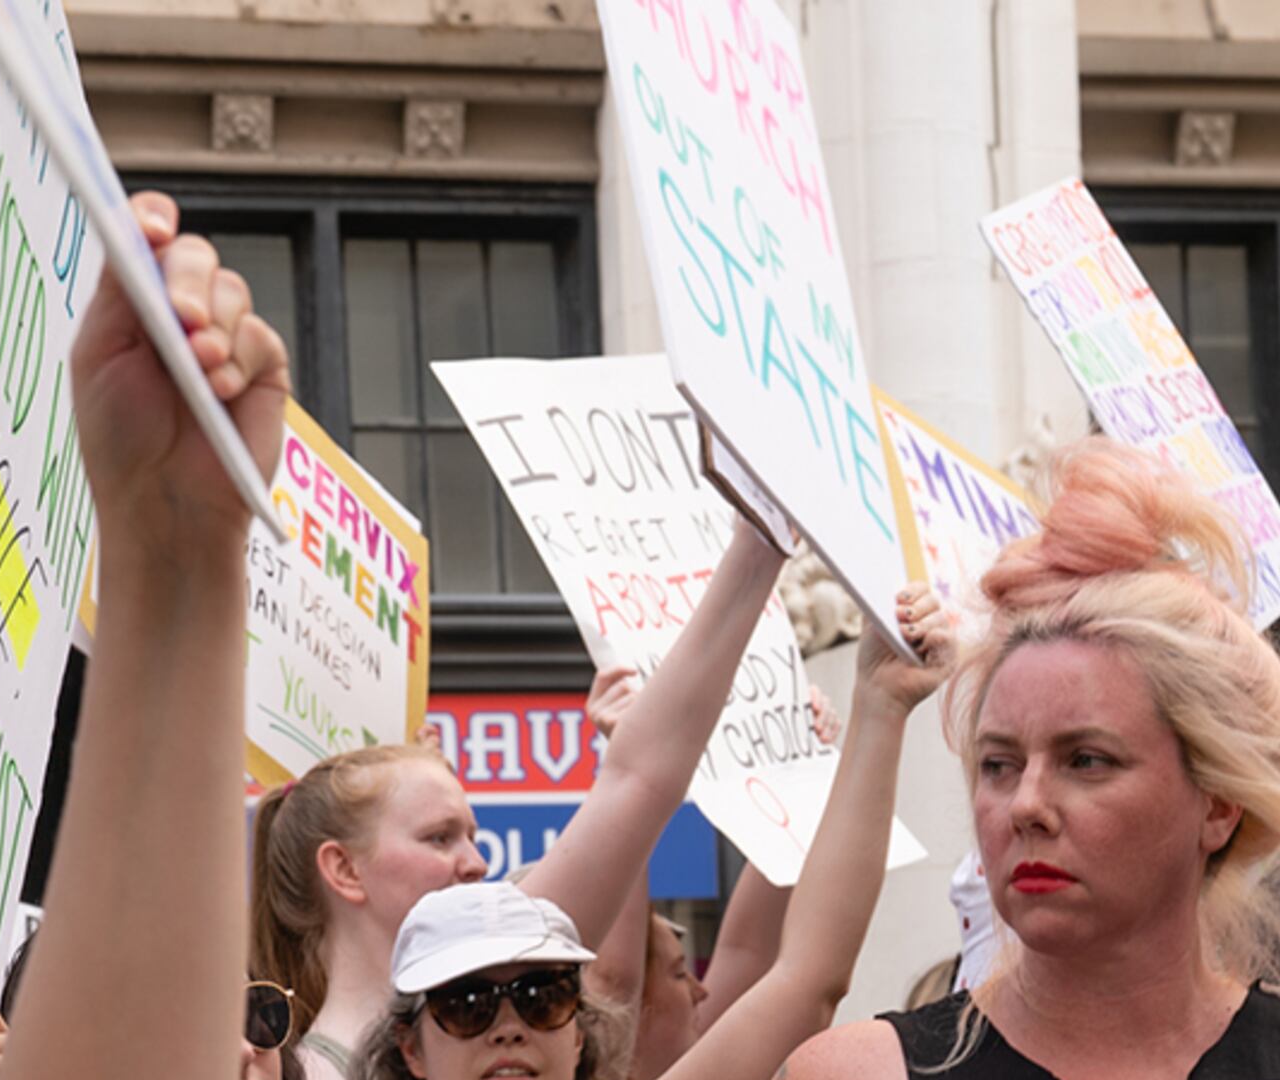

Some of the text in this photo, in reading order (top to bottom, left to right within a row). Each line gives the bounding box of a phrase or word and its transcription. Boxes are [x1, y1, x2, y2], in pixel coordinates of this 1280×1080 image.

[632, 61, 855, 382] OUT OF MY
[658, 166, 894, 543] STATE
[477, 407, 705, 494] I DONT
[285, 436, 422, 611] CERVIX
[530, 510, 677, 562] REGRET
[245, 535, 291, 587] EST
[298, 575, 382, 682] DECISION
[293, 617, 352, 692] MAKES
[722, 644, 800, 707] ODY
